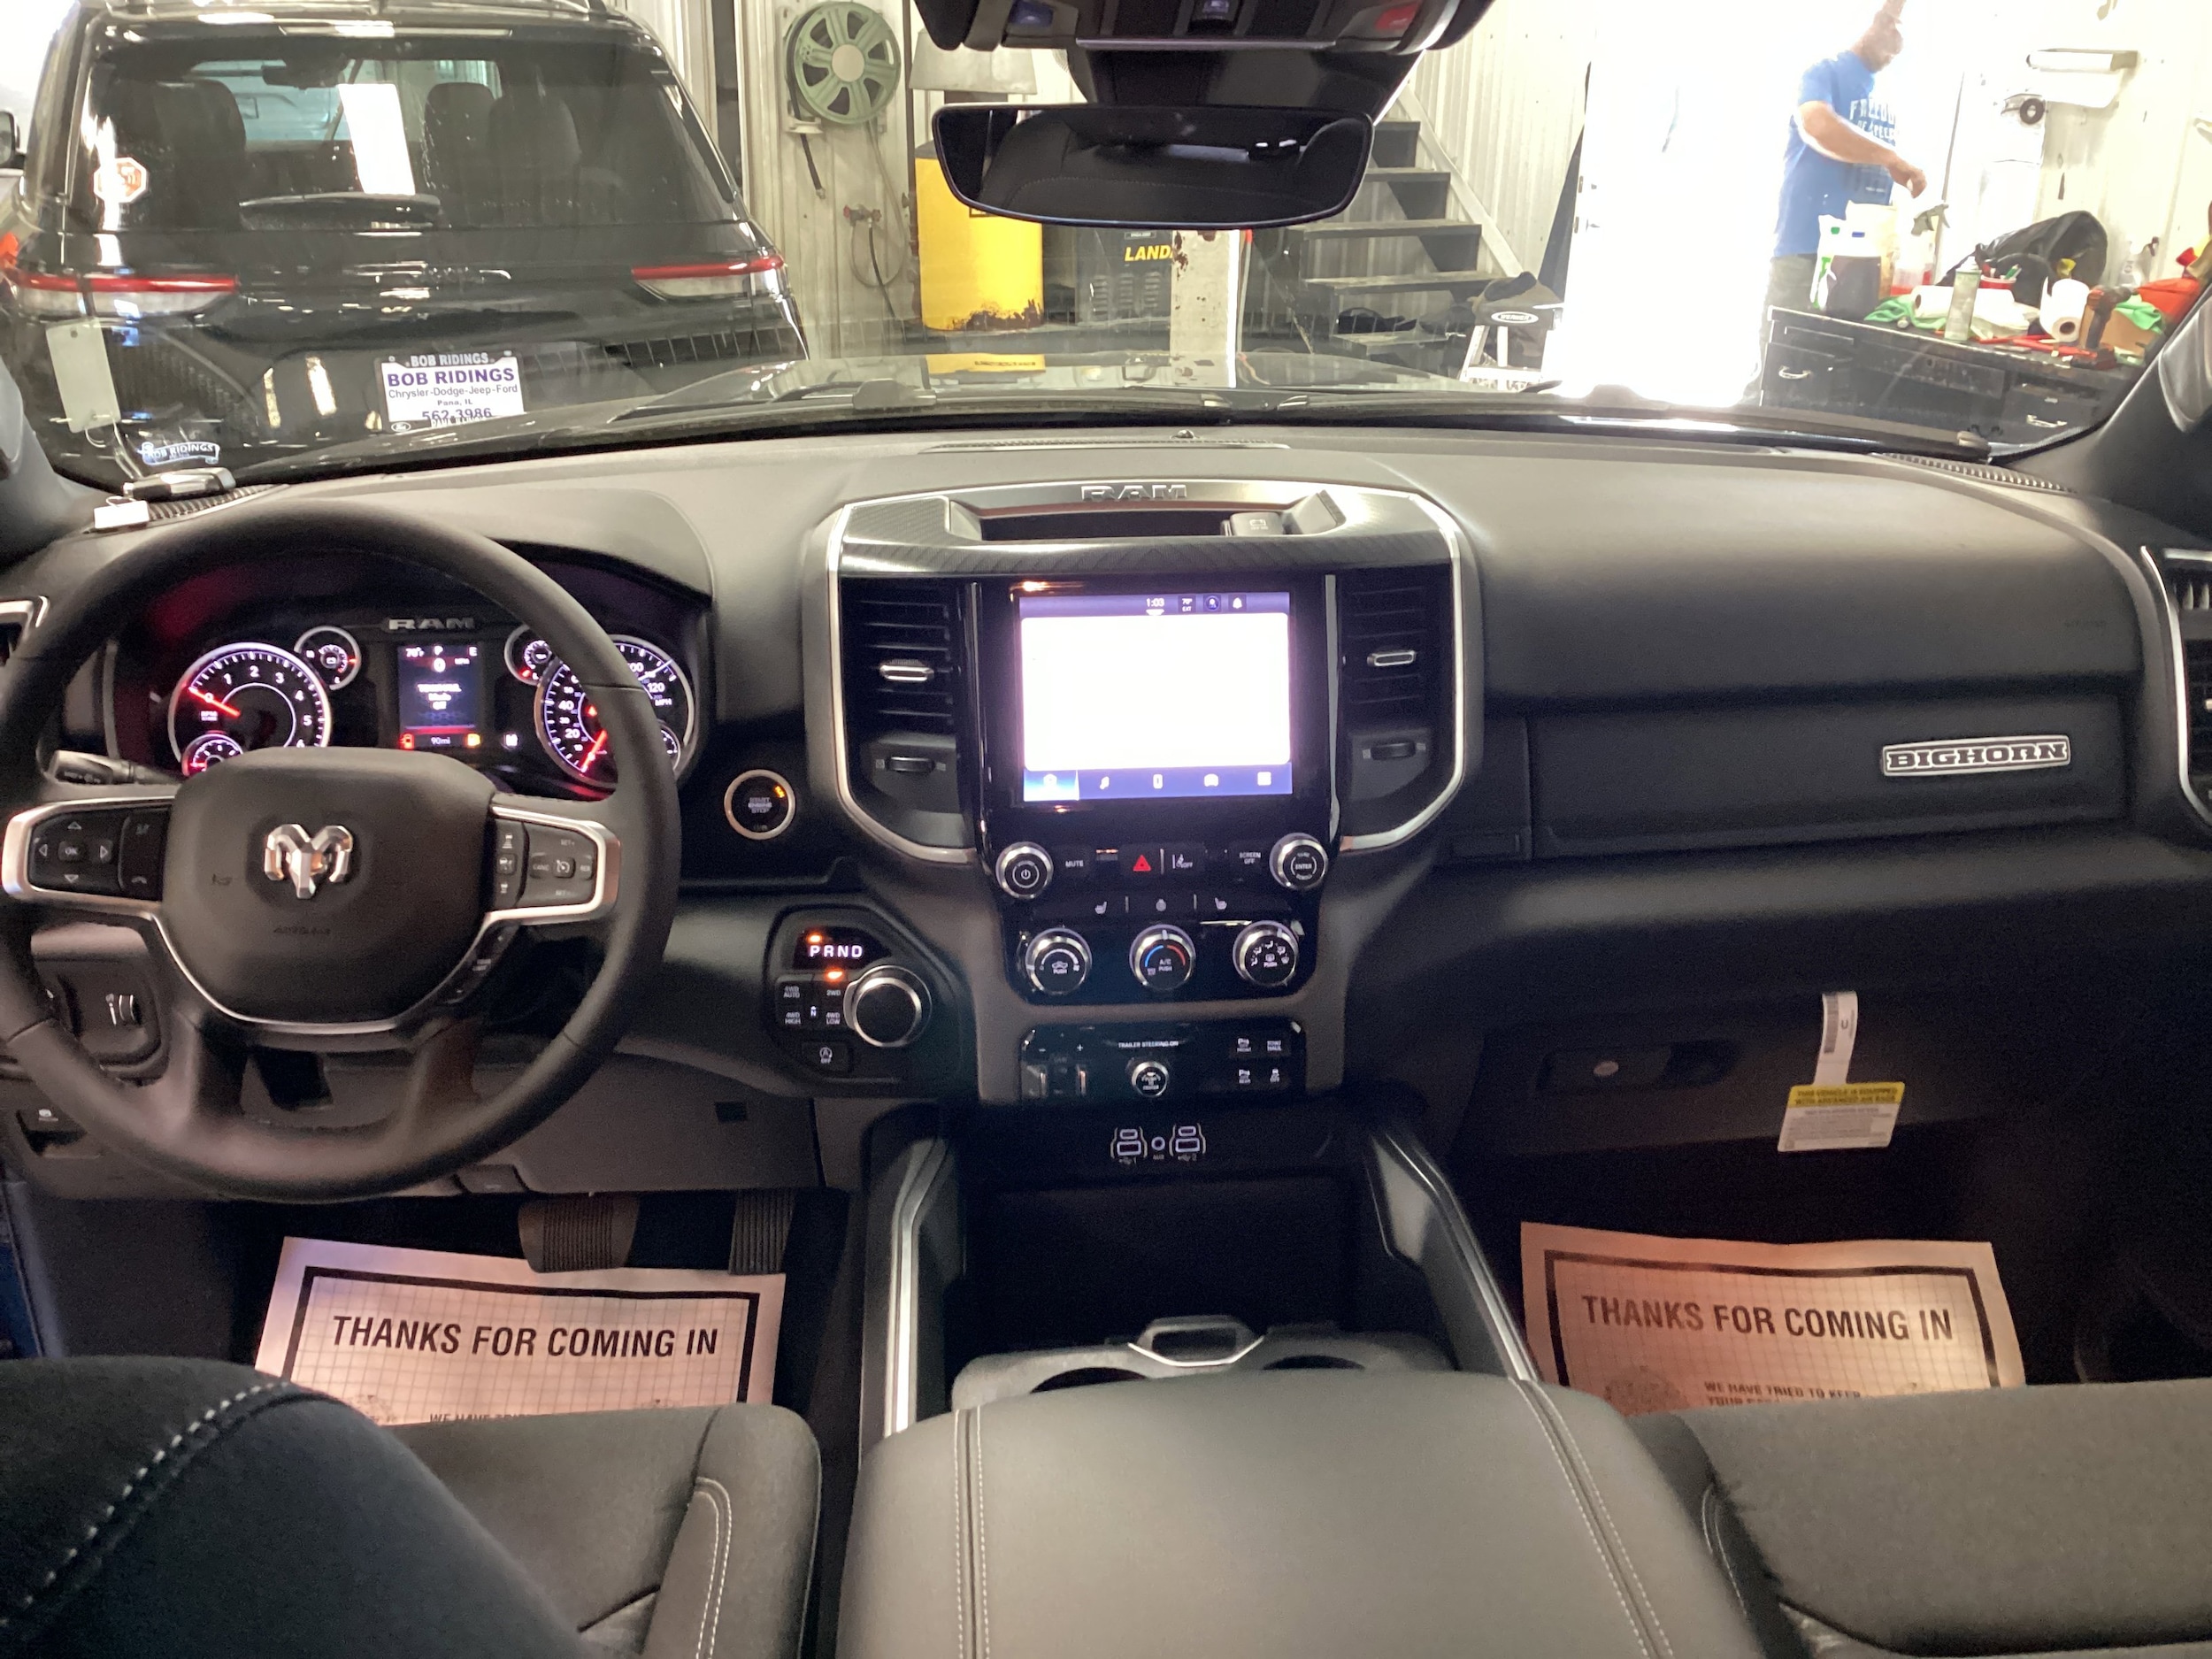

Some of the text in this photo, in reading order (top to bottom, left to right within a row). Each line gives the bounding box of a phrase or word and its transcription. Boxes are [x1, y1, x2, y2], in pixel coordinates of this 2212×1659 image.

[1125, 244, 1173, 262] LAND
[410, 352, 488, 367] BOB RIDINGS
[388, 368, 515, 387] BOB RIDINGS
[388, 384, 518, 400] Chrysler-Dodge-Jeep-Ford
[170, 442, 213, 455] RIDINGS
[1081, 485, 1187, 501] RAM
[388, 618, 475, 630] RAM
[469, 646, 478, 657] E
[250, 665, 259, 678] 2
[627, 663, 644, 672] 00
[223, 673, 232, 685] 1
[275, 672, 284, 684] 3
[648, 682, 665, 693] 120
[295, 690, 304, 701] 4
[558, 700, 574, 710] 40
[303, 715, 312, 726] 5
[565, 729, 580, 739] 20
[1886, 742, 2067, 771] BIGHORN
[1582, 1294, 1954, 1340] THANKS FOR COMING IN
[333, 1315, 718, 1357] THANKS FOR COMING IN
[1704, 1381, 1723, 1393] WE
[1728, 1383, 1762, 1395] HAVE
[1766, 1385, 1803, 1398] TRIED
[1808, 1387, 1825, 1399] TO
